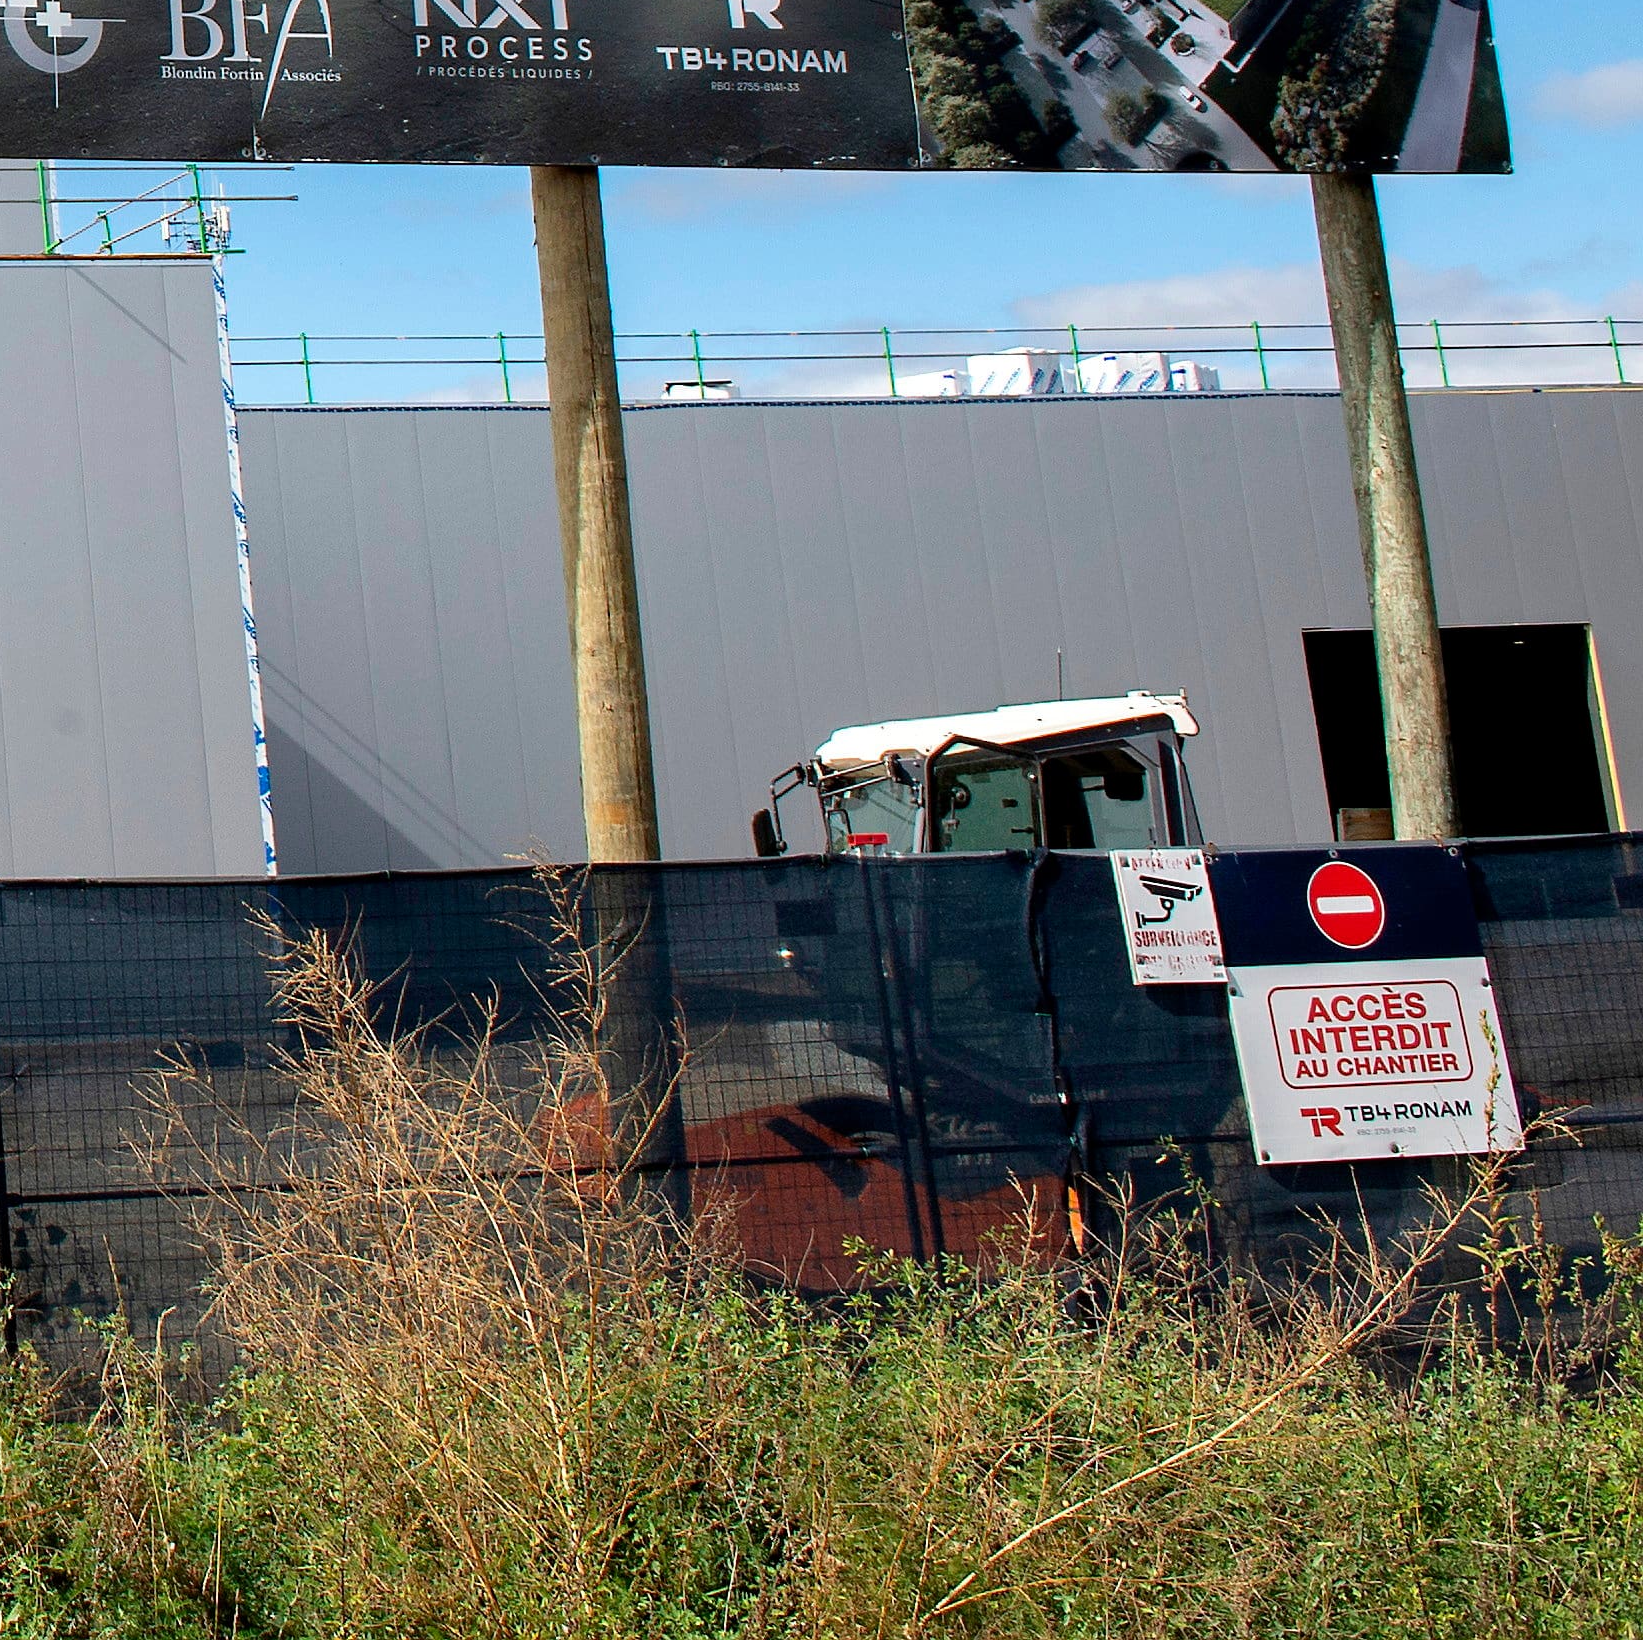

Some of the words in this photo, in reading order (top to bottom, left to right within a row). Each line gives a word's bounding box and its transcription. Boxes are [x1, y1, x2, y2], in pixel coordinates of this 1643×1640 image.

[415, 34, 593, 61] PROCESS
[161, 64, 217, 81] Blondin
[220, 66, 265, 81] Fortin
[280, 67, 342, 82] Associés
[428, 64, 505, 78] PROCÉDÉS
[512, 67, 581, 79] LIQUIDES
[1307, 986, 1428, 1024] ACCÈS
[1288, 1022, 1453, 1055] INTERDIT
[1295, 1059, 1329, 1079] AU
[1336, 1052, 1460, 1077] CHANTIER
[1299, 1106, 1345, 1138] TR
